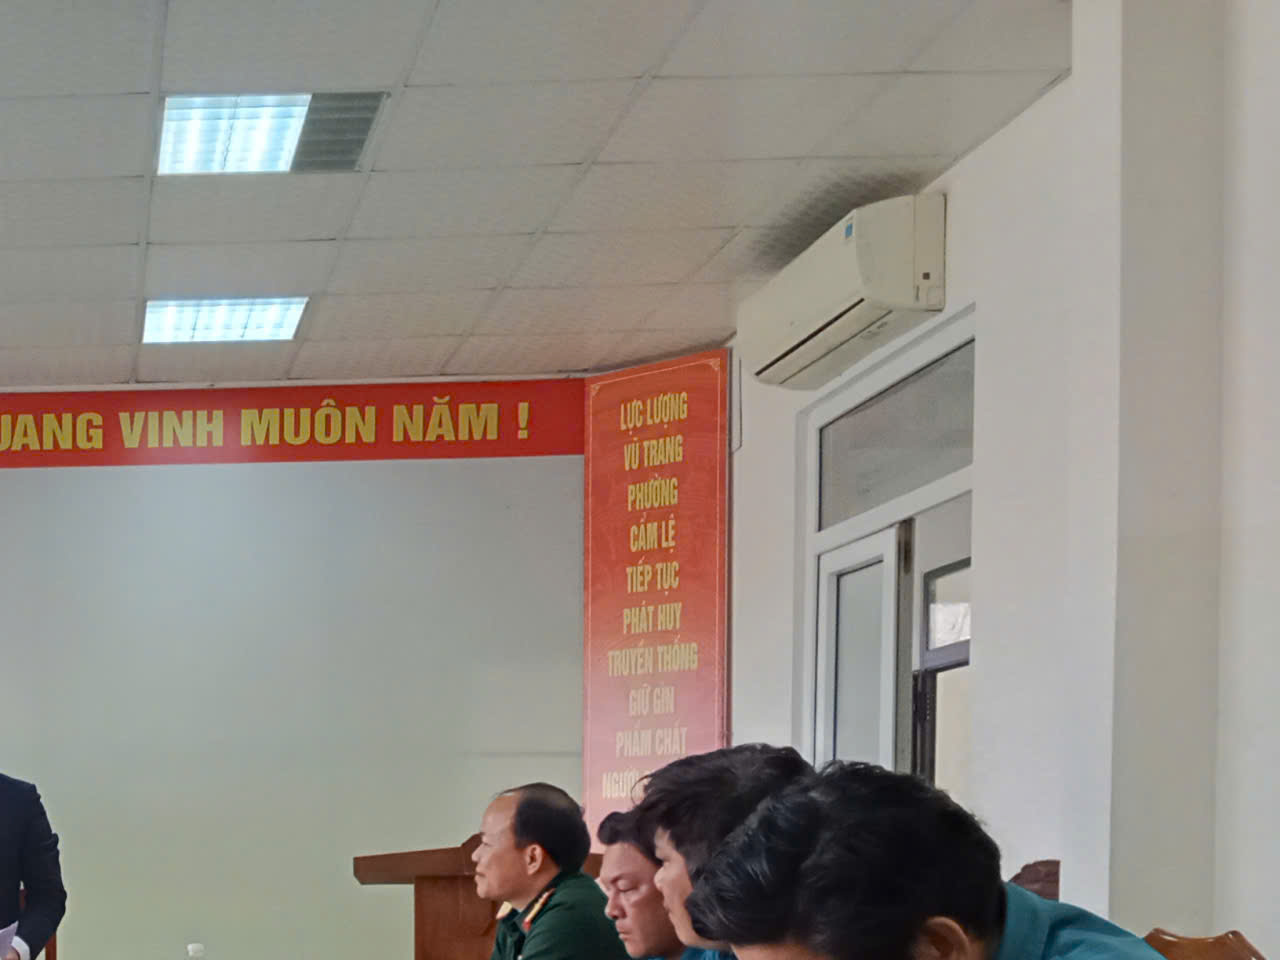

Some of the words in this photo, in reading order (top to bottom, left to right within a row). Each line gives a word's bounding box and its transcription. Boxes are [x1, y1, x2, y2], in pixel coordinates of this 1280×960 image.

[119, 409, 224, 451] VINH
[240, 398, 377, 446] MUÔN
[392, 395, 500, 443] NĂM
[518, 402, 530, 439] !
[620, 399, 644, 436] LỰC
[646, 391, 689, 429] LƯỢNG
[643, 434, 685, 469] TRANG
[628, 472, 679, 512] PHƯỜNG
[626, 555, 653, 594] TIẾP
[656, 560, 680, 596] TỤC
[623, 600, 654, 635] PHÁT
[658, 602, 683, 632] HUY
